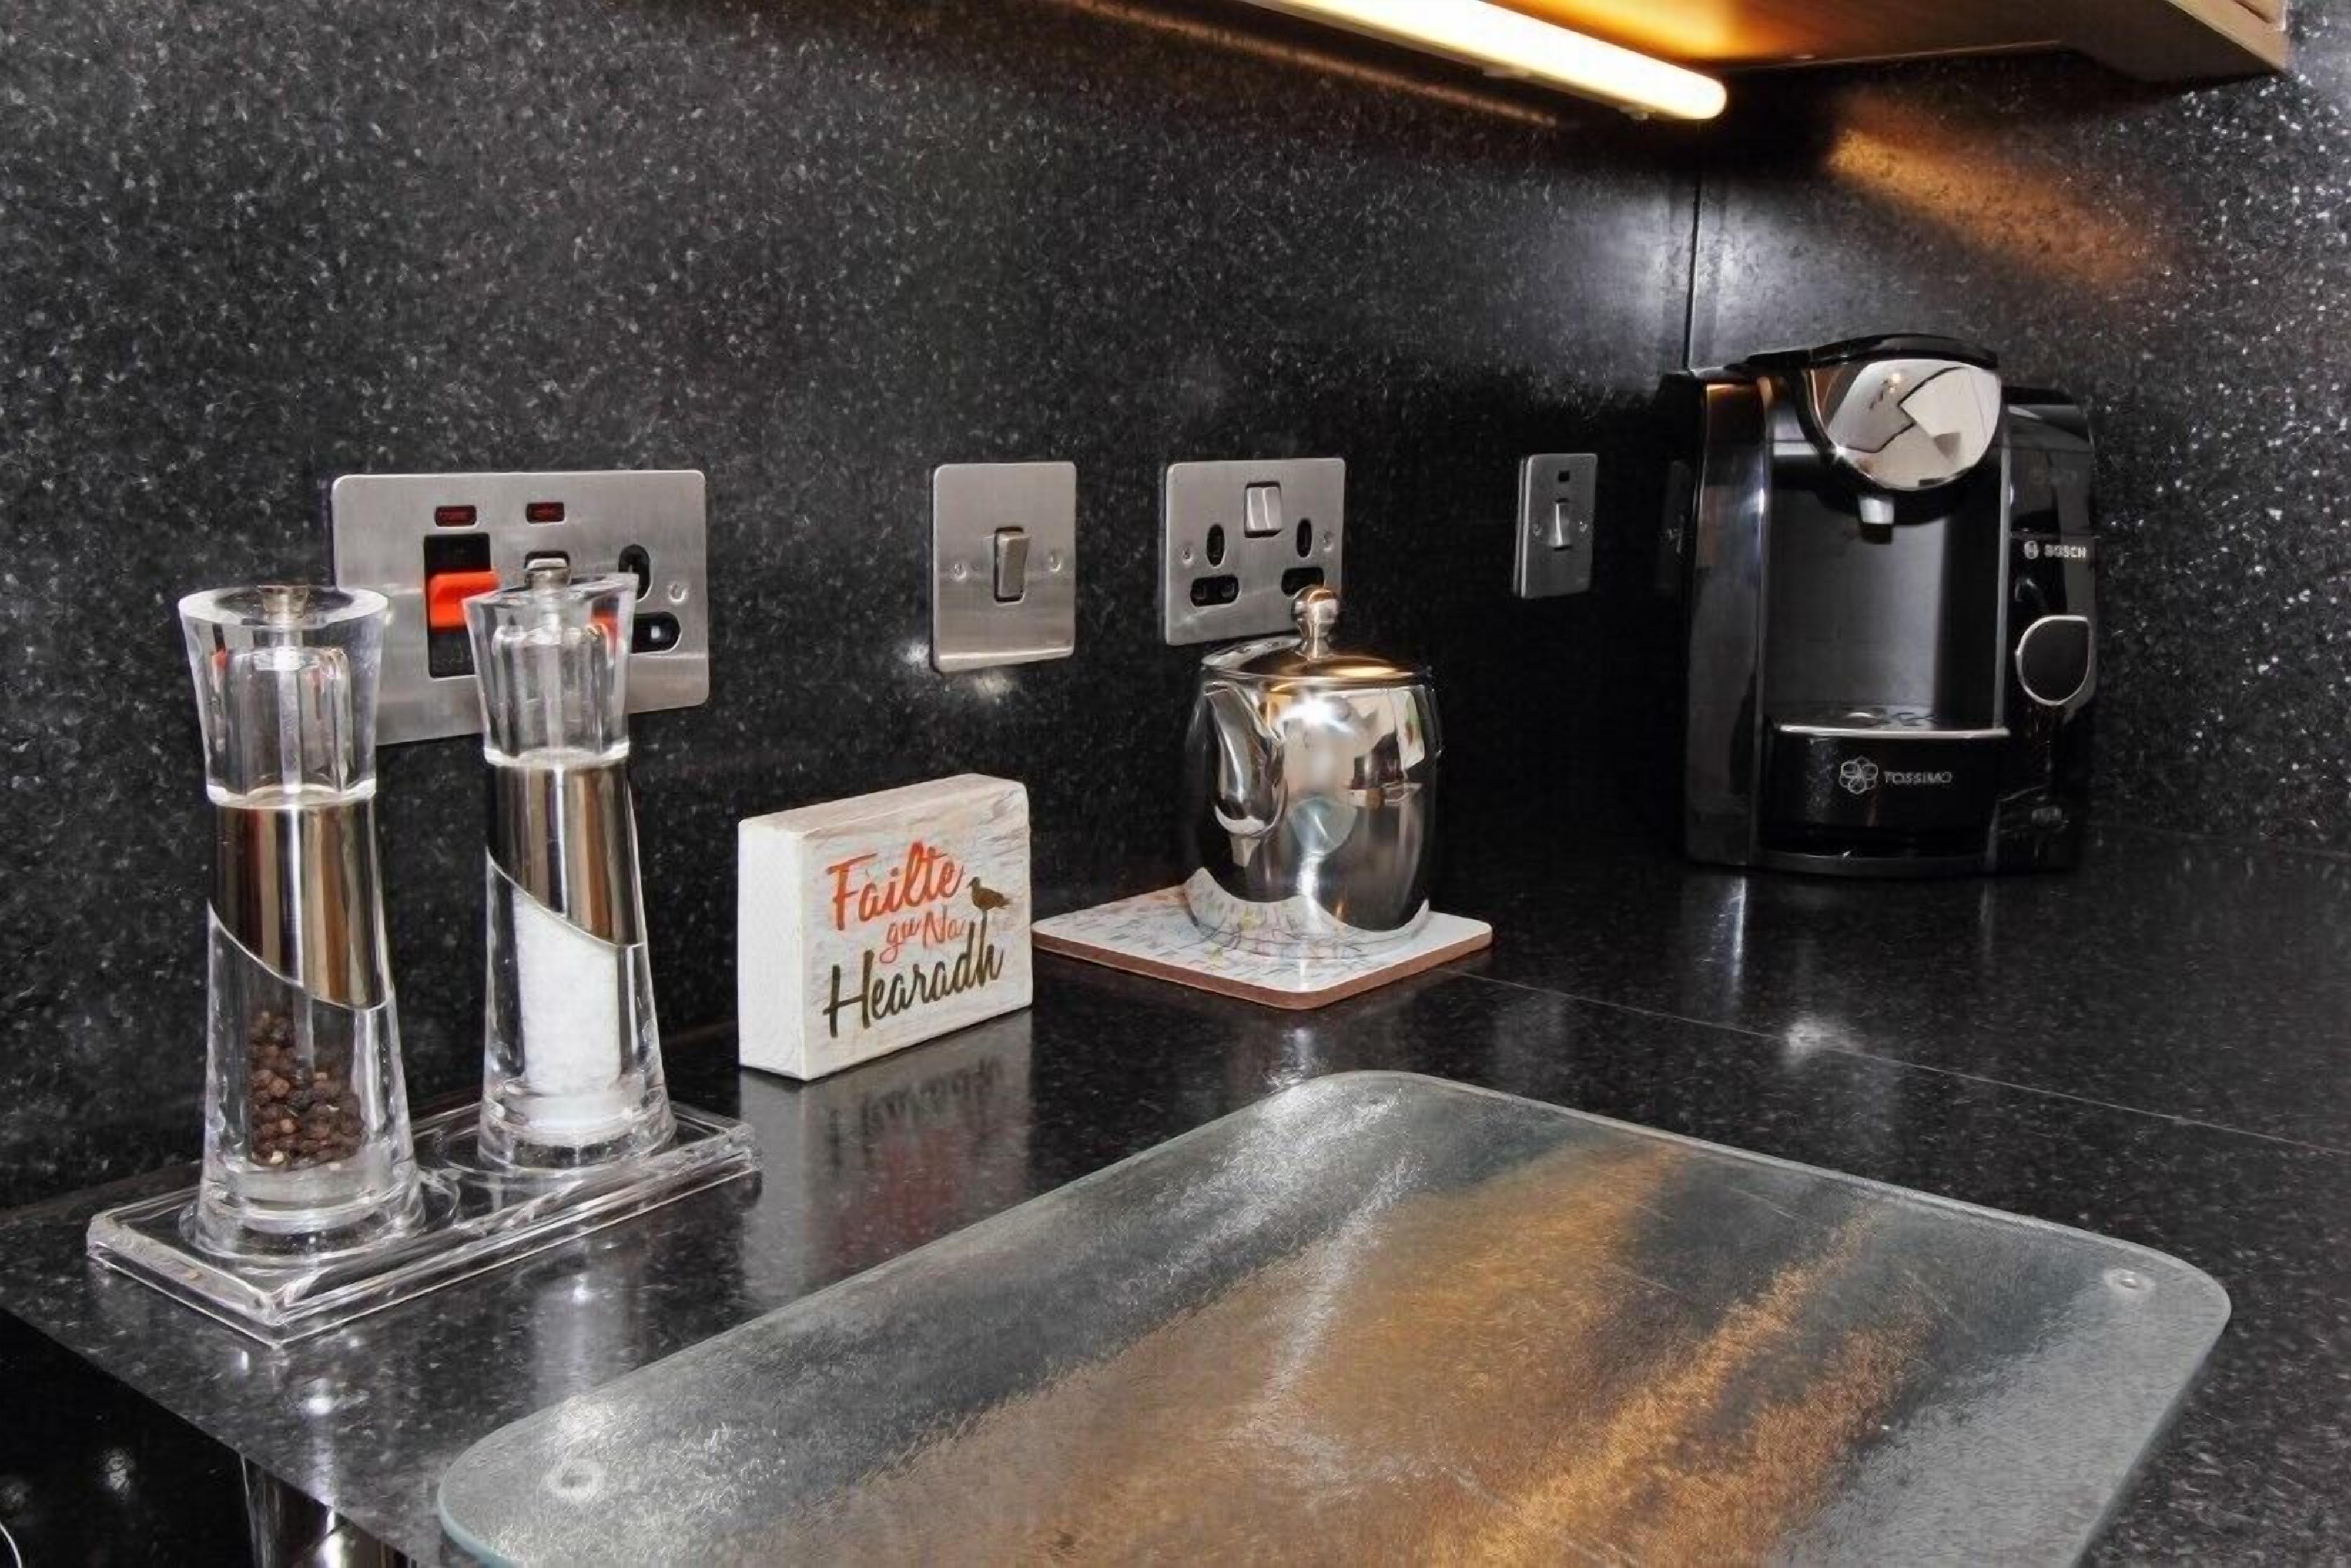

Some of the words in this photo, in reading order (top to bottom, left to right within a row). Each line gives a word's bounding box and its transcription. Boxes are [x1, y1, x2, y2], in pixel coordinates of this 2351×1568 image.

[2045, 544, 2087, 558] BOSCH
[923, 905, 966, 950] Na
[823, 911, 1004, 1038] Hearadh
